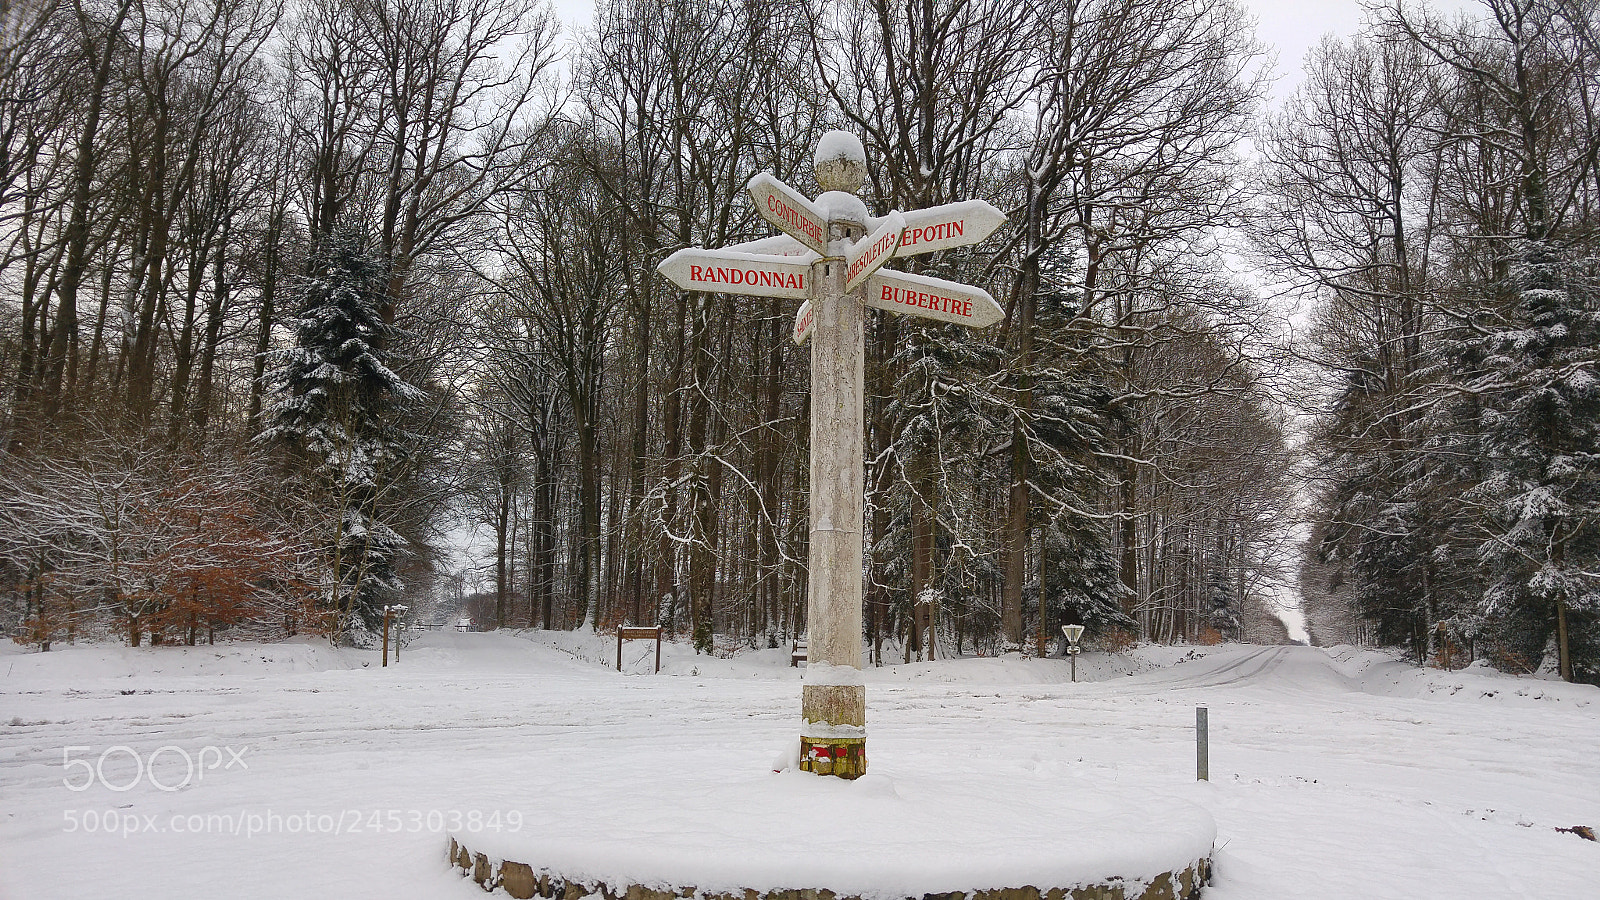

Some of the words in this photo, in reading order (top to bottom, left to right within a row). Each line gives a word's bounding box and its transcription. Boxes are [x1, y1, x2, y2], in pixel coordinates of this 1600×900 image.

[767, 194, 823, 244] CONTURBIE
[898, 219, 964, 248] ÉPOTIN
[690, 264, 804, 290] RANDONNAI
[880, 284, 973, 318] BUBERTRÉ
